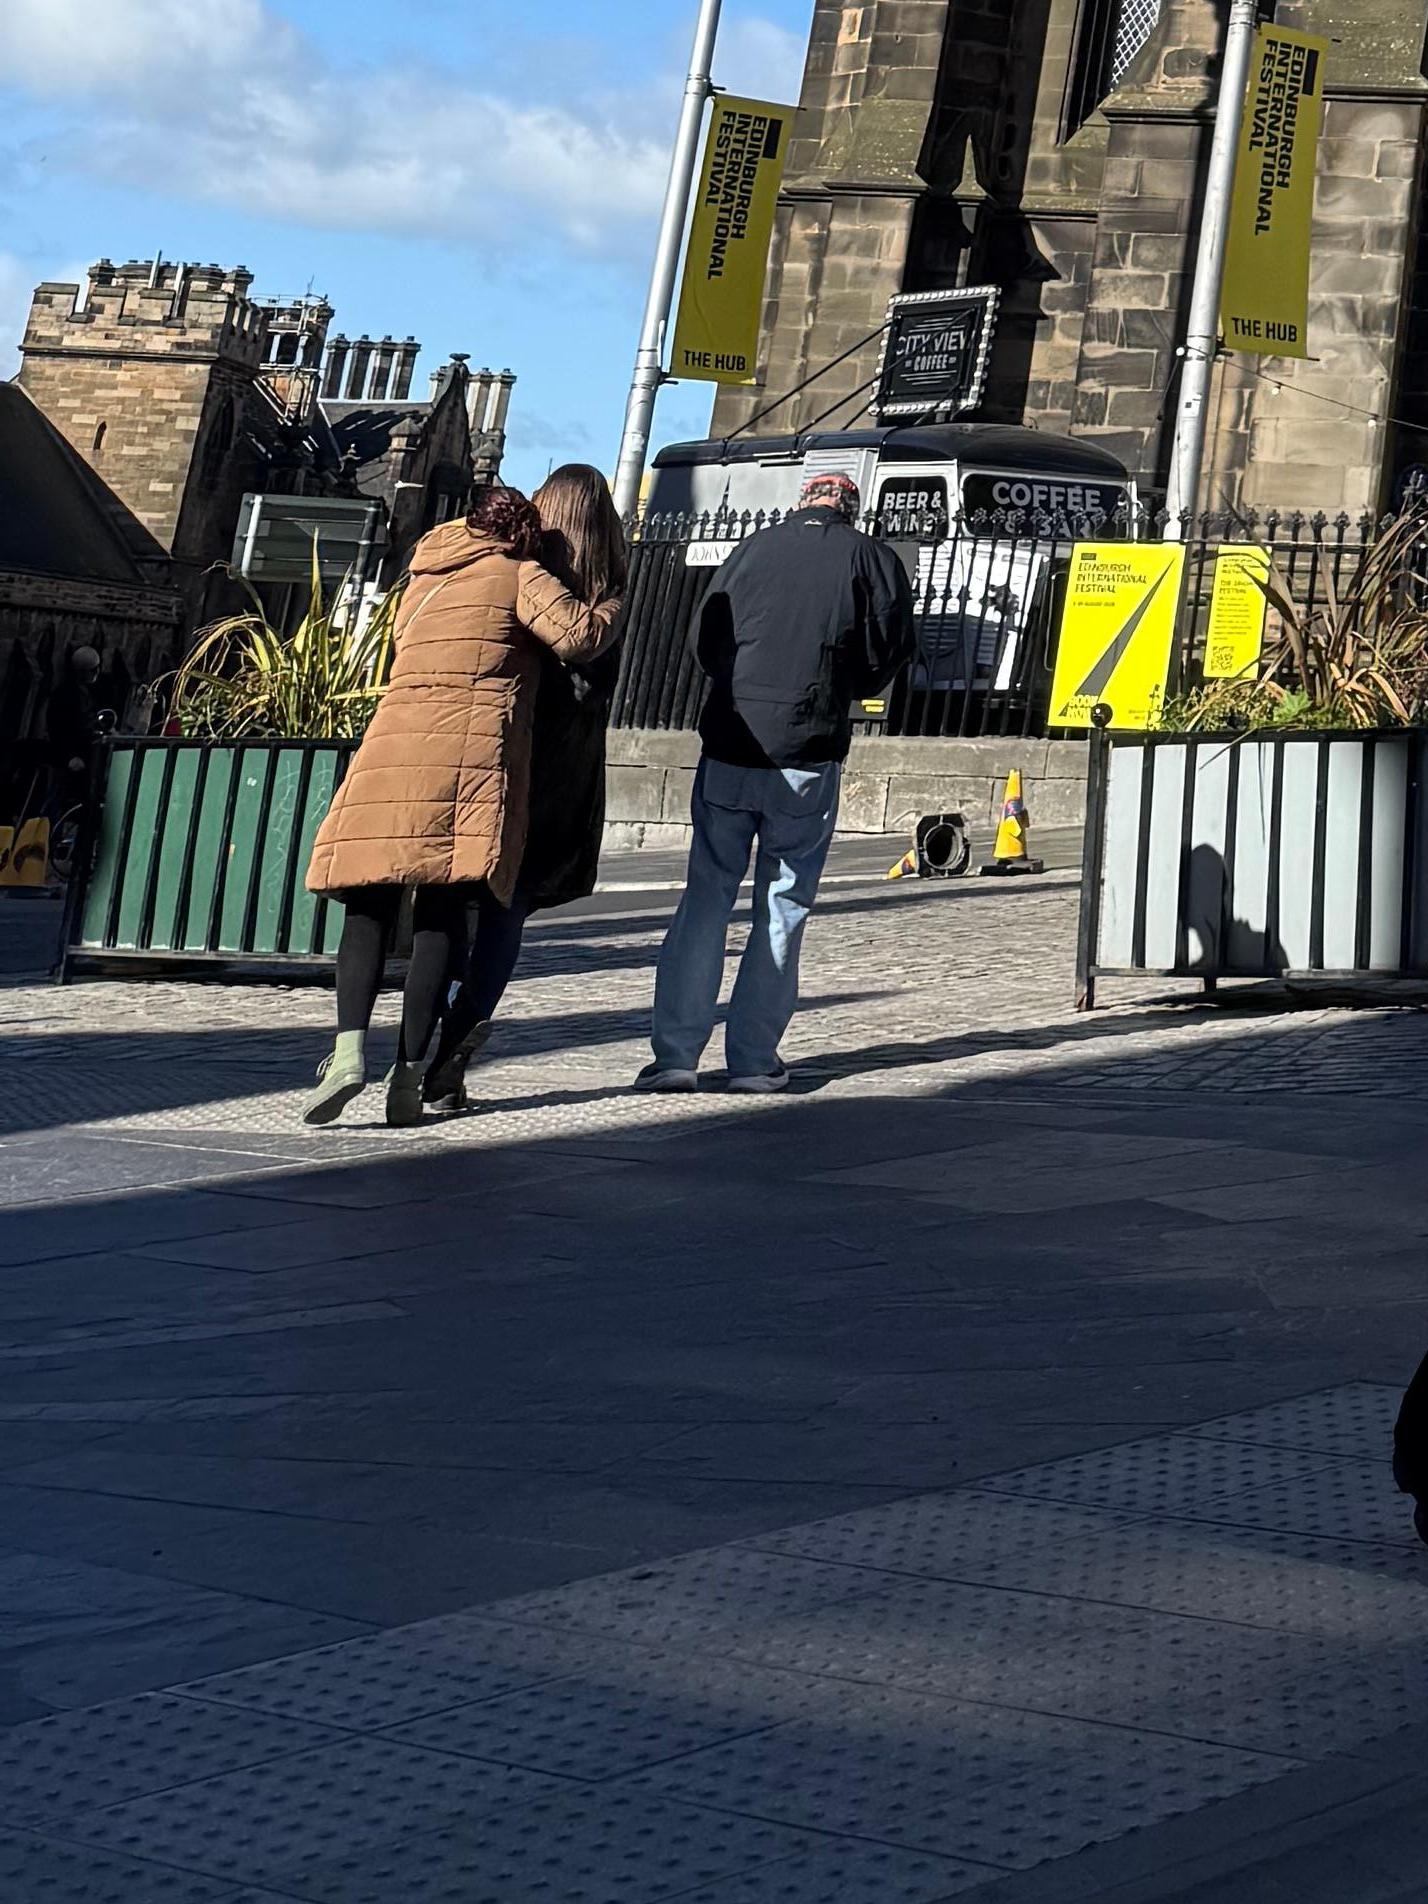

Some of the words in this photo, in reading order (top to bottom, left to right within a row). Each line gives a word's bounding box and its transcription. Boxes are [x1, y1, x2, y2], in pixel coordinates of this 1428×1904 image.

[1248, 38, 1278, 152] FESTIVAL
[1275, 45, 1306, 189] EDINBURGH
[704, 110, 738, 208] FESTIVAL
[1254, 42, 1293, 236] INTERNATIONAL
[707, 113, 753, 280] INTERNATIONAL
[730, 115, 769, 240] EDINBURGH
[683, 350, 712, 369] THE
[714, 352, 747, 372] HUB
[896, 334, 932, 356] CITY
[913, 354, 949, 371] COFFEE
[1231, 317, 1262, 338] THE
[1265, 321, 1298, 343] HUB
[882, 491, 929, 510] BEER
[930, 490, 942, 508] &
[992, 481, 1102, 513] COFFEE
